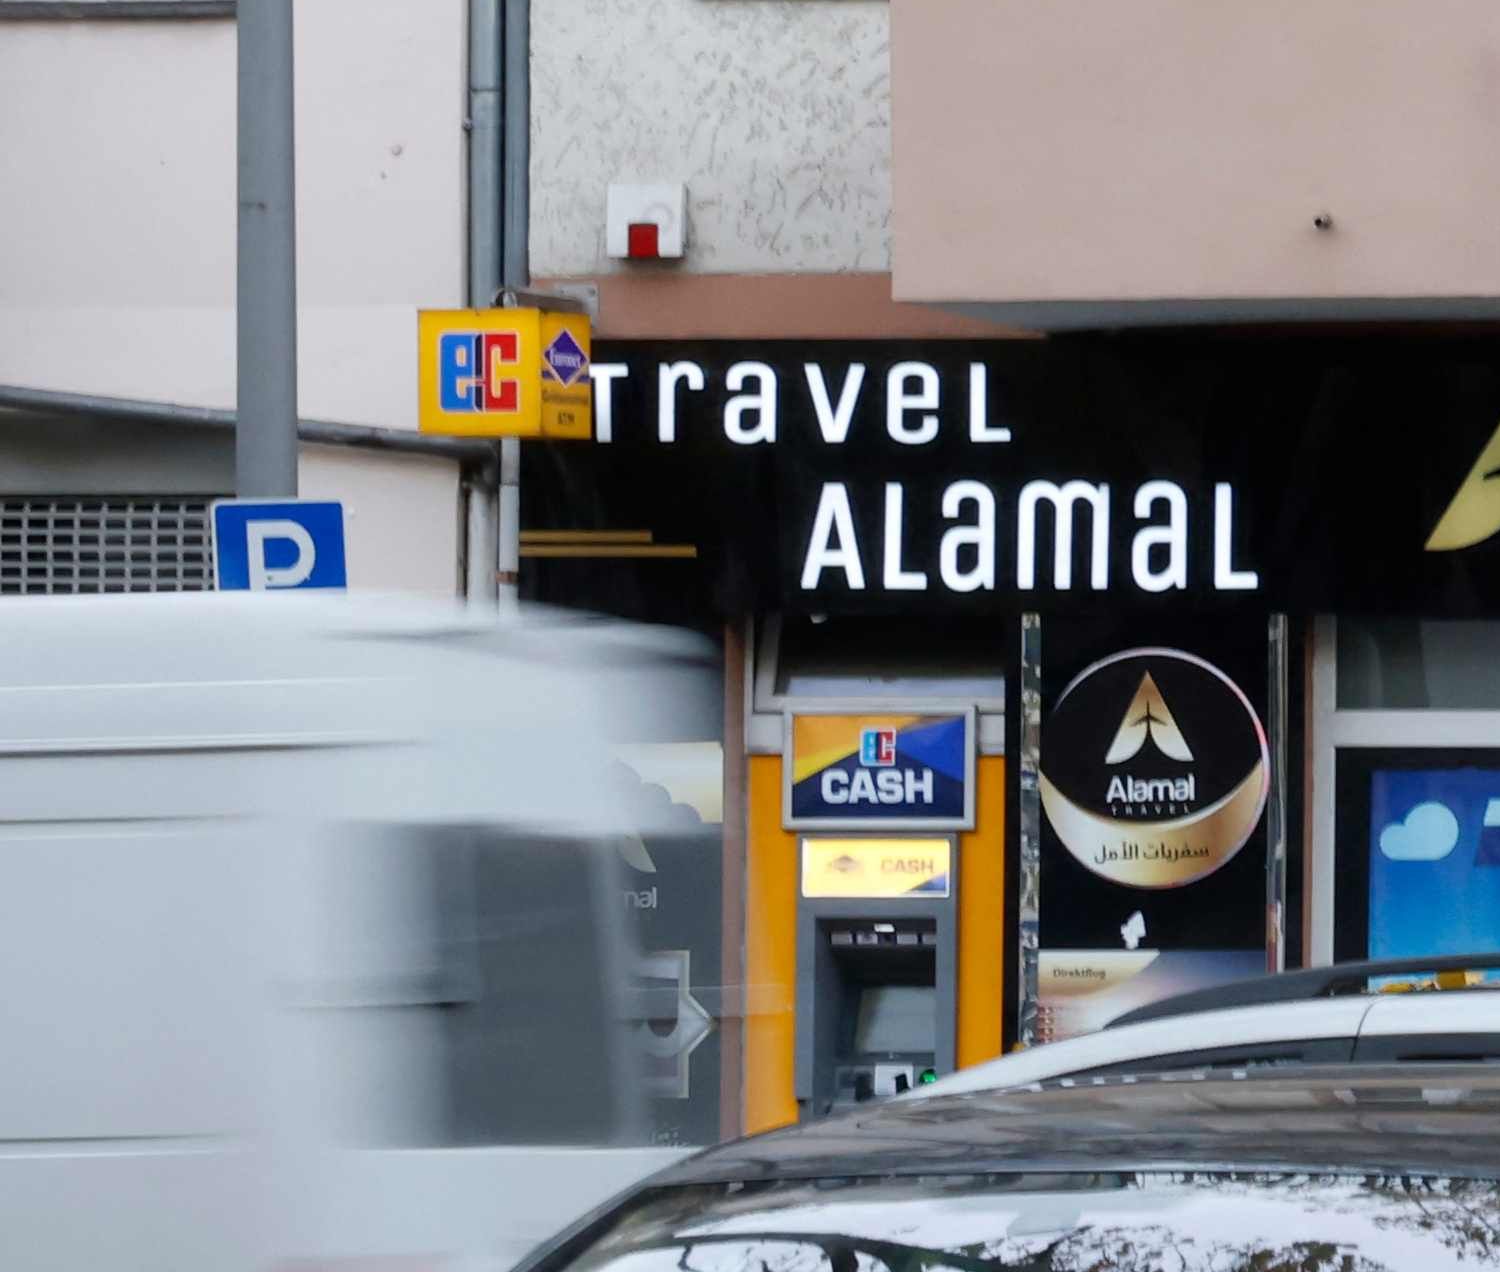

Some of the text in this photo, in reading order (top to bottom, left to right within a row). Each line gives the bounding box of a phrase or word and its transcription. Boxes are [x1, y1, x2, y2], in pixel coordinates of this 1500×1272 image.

[245, 519, 317, 592] P
[821, 768, 933, 805] CASH
[1106, 773, 1196, 804] Alamal
[1110, 804, 1190, 816] TRAVEL
[1093, 839, 1210, 865] سفريات الأمل
[880, 858, 935, 875] CASH
[1052, 966, 1107, 981] Direktflug
